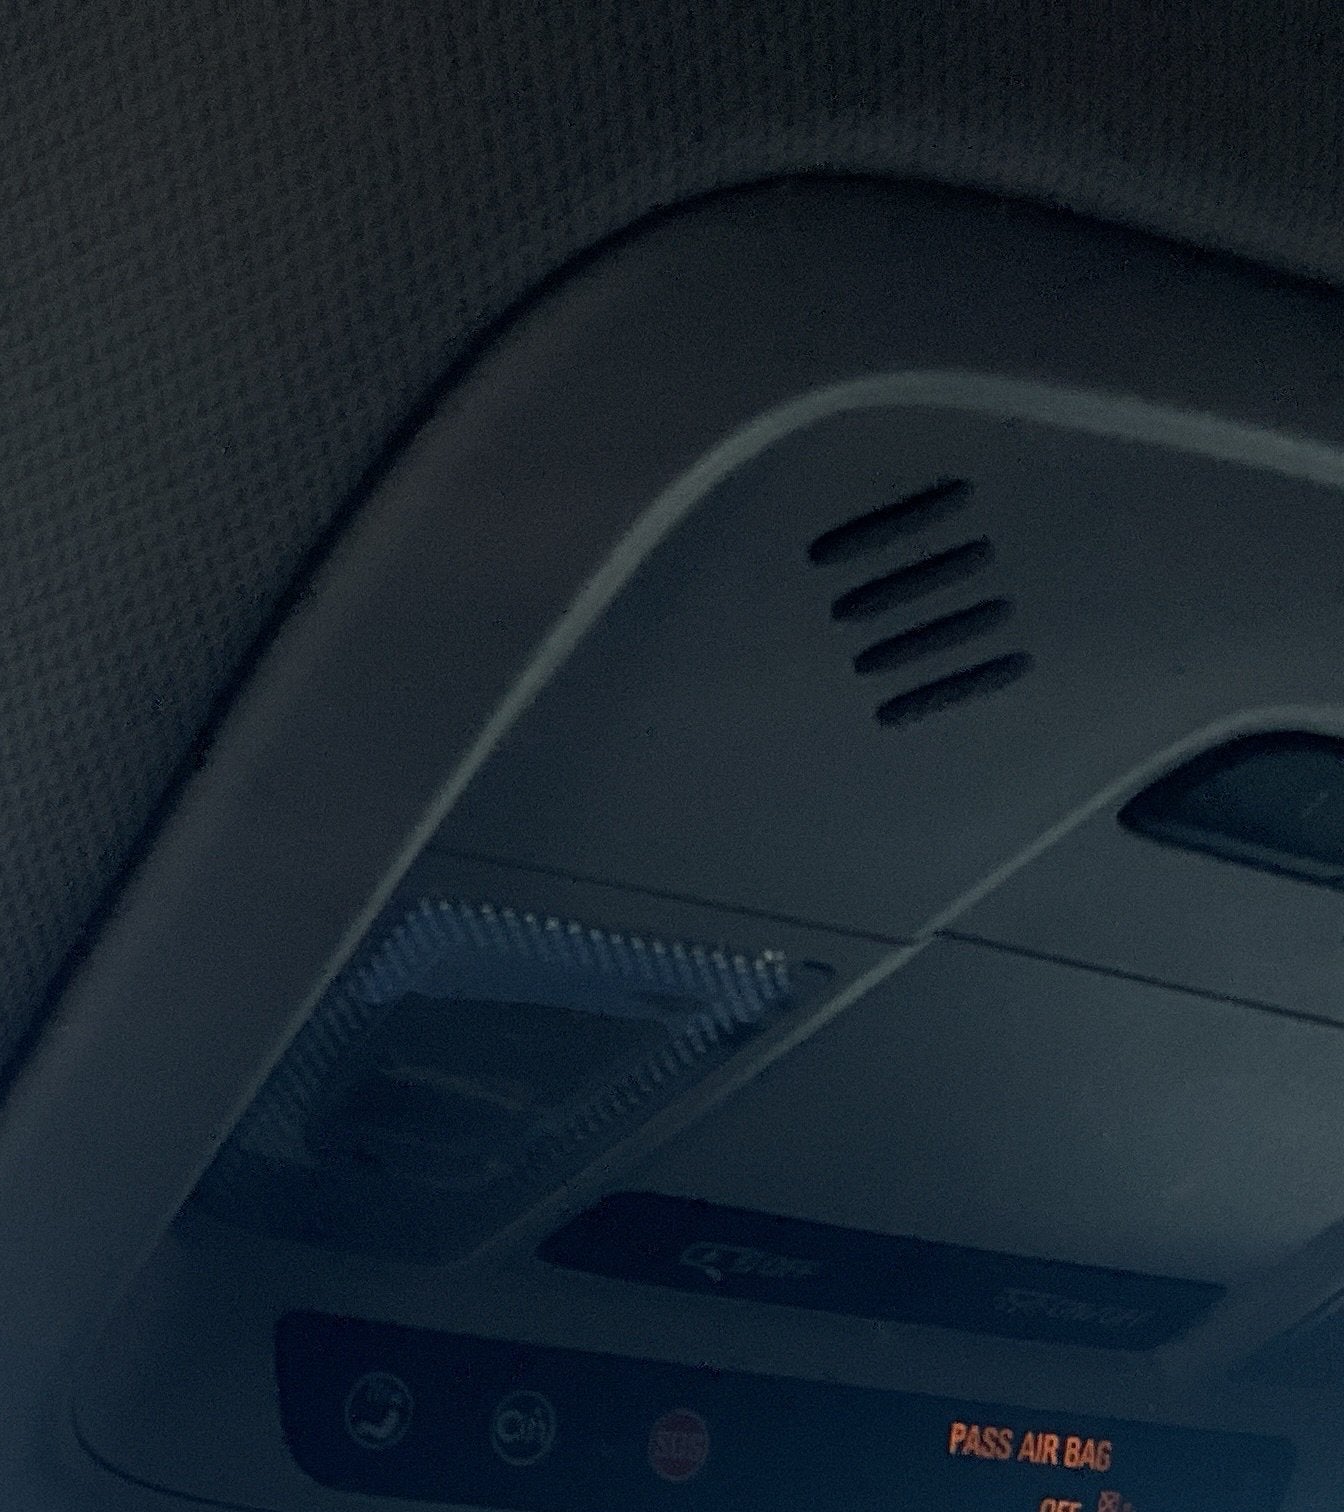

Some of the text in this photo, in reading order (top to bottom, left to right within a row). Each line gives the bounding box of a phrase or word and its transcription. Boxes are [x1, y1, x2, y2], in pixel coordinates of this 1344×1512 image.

[949, 1422, 1113, 1472] PASS AIR BAG
